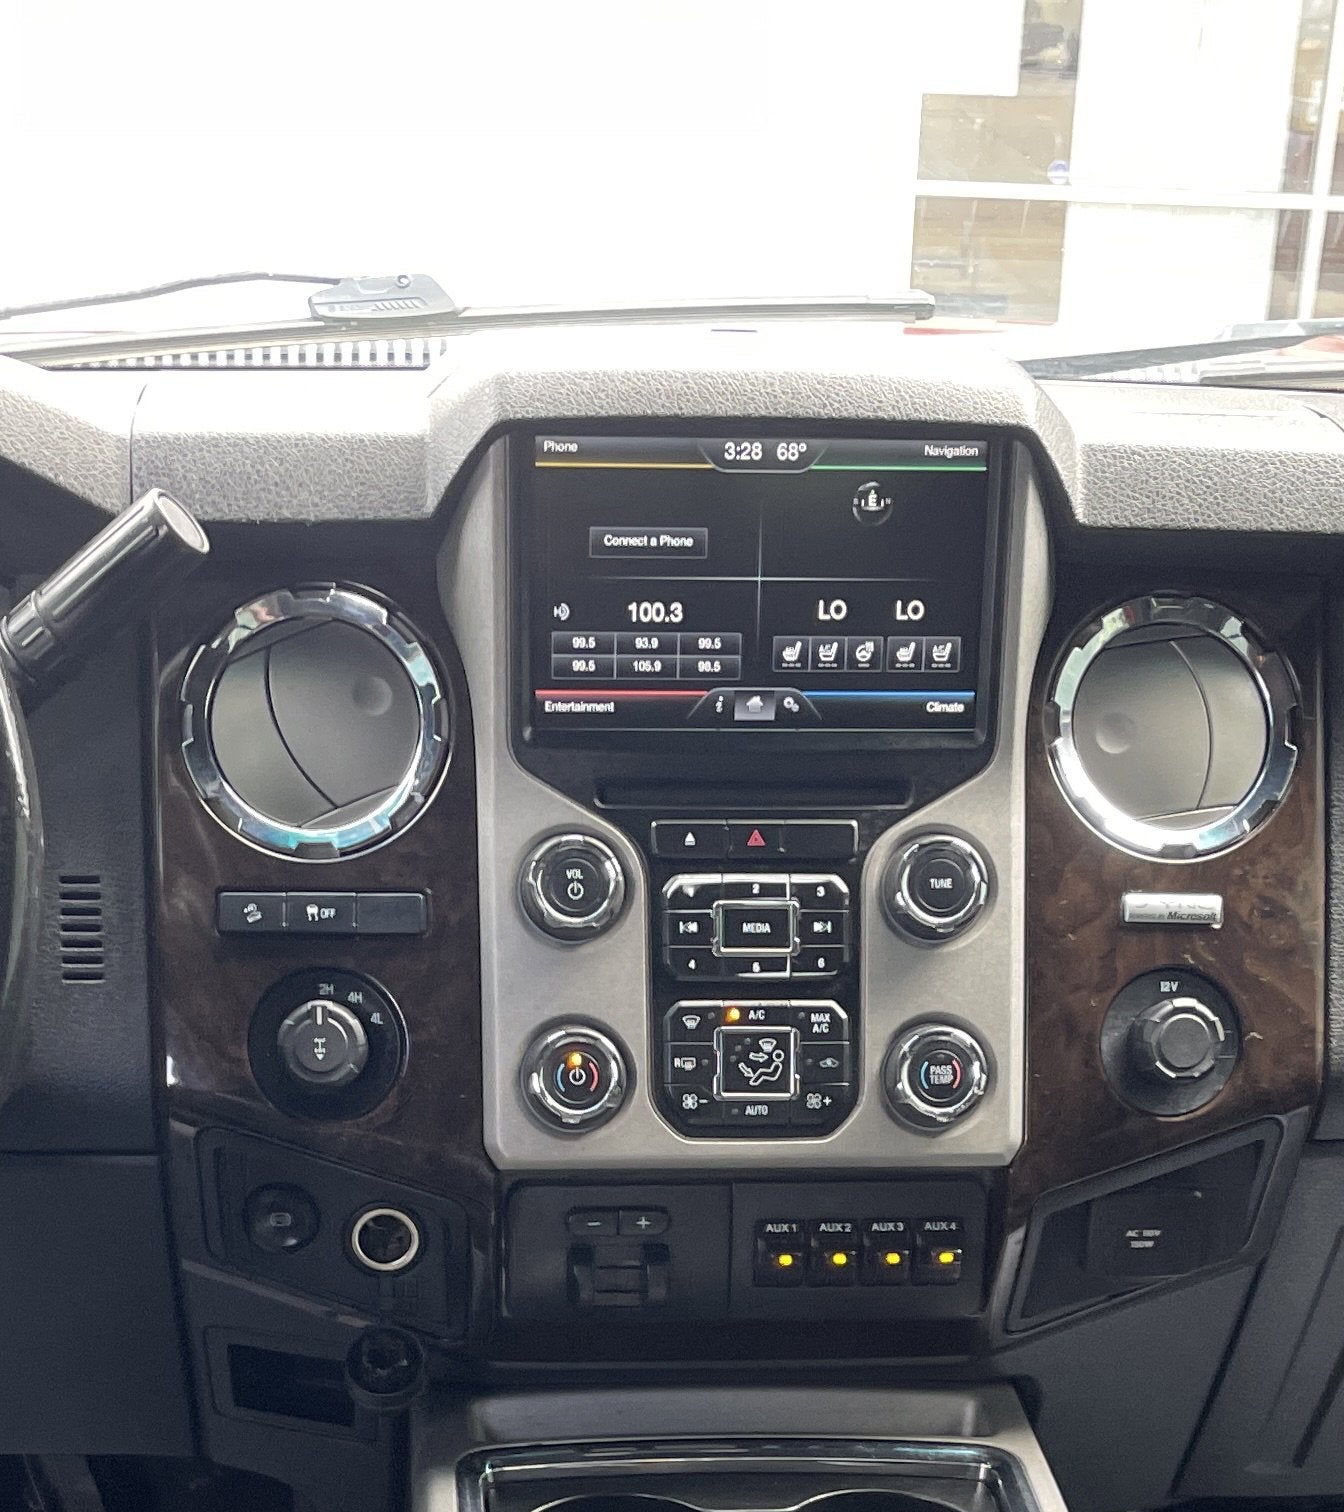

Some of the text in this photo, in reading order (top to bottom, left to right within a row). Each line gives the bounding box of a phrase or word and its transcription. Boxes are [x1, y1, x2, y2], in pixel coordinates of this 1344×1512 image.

[543, 440, 578, 453] Phone
[724, 442, 763, 460] 3:28
[924, 445, 979, 459] Navigation
[603, 534, 694, 548] Connect a Phone
[628, 602, 683, 623] 100.3
[818, 600, 847, 620] LO
[896, 600, 925, 621] LO
[544, 701, 614, 713] Entertainment
[926, 702, 965, 713] Climate
[565, 869, 583, 880] VOL
[752, 884, 760, 894] 2
[929, 878, 953, 889] TUNE
[817, 886, 825, 897] 3
[320, 908, 336, 919] OFF
[1167, 911, 1217, 921] Microsoft
[742, 922, 771, 934] MEDIA
[688, 959, 696, 970] 4
[319, 984, 334, 996] 2H
[1159, 981, 1179, 992] 12V
[347, 992, 363, 1004] 4H
[370, 1013, 384, 1025] 4L
[748, 1010, 765, 1020] A/C
[811, 1013, 830, 1023] MAX
[812, 1023, 829, 1033] A/C
[929, 1065, 953, 1075] PASS
[929, 1075, 954, 1085] TEMP
[745, 1105, 769, 1116] AUTO
[765, 1223, 797, 1233] AUX 1
[819, 1223, 852, 1233] AUX 2
[871, 1222, 904, 1232] AUX 3
[924, 1221, 957, 1231] AUX 4
